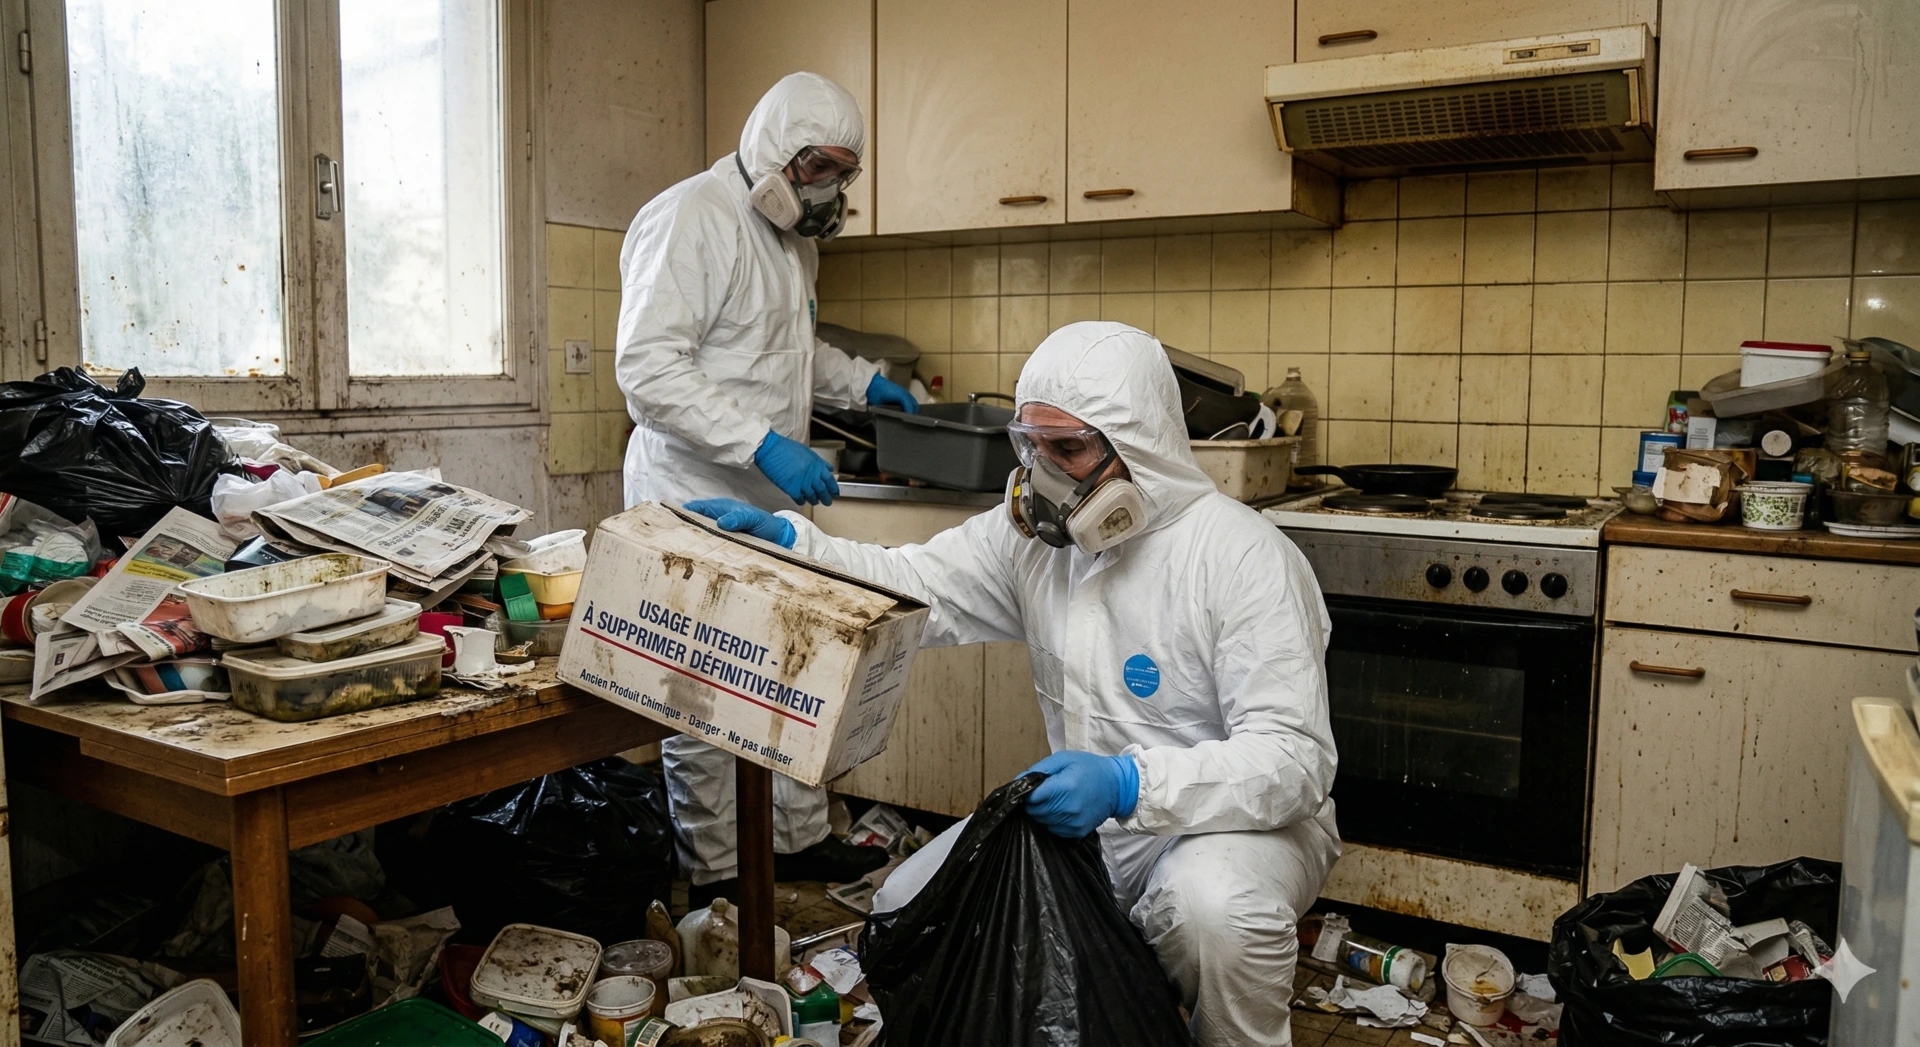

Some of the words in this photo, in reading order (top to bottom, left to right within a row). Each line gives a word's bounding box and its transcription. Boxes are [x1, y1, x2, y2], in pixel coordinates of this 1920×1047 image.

[582, 600, 594, 625] À
[597, 611, 687, 664] SUPPRIMER
[689, 649, 826, 718] DÉFINITIVEMENT
[639, 599, 692, 637] USAGE
[693, 621, 769, 667] INTERDIT
[580, 668, 608, 689] Ancien
[609, 680, 640, 702] Produit
[641, 694, 681, 720] Chimique
[688, 714, 721, 736] Danger
[727, 730, 741, 745] Ne
[741, 738, 759, 752] pas
[760, 745, 793, 766] utiliser
